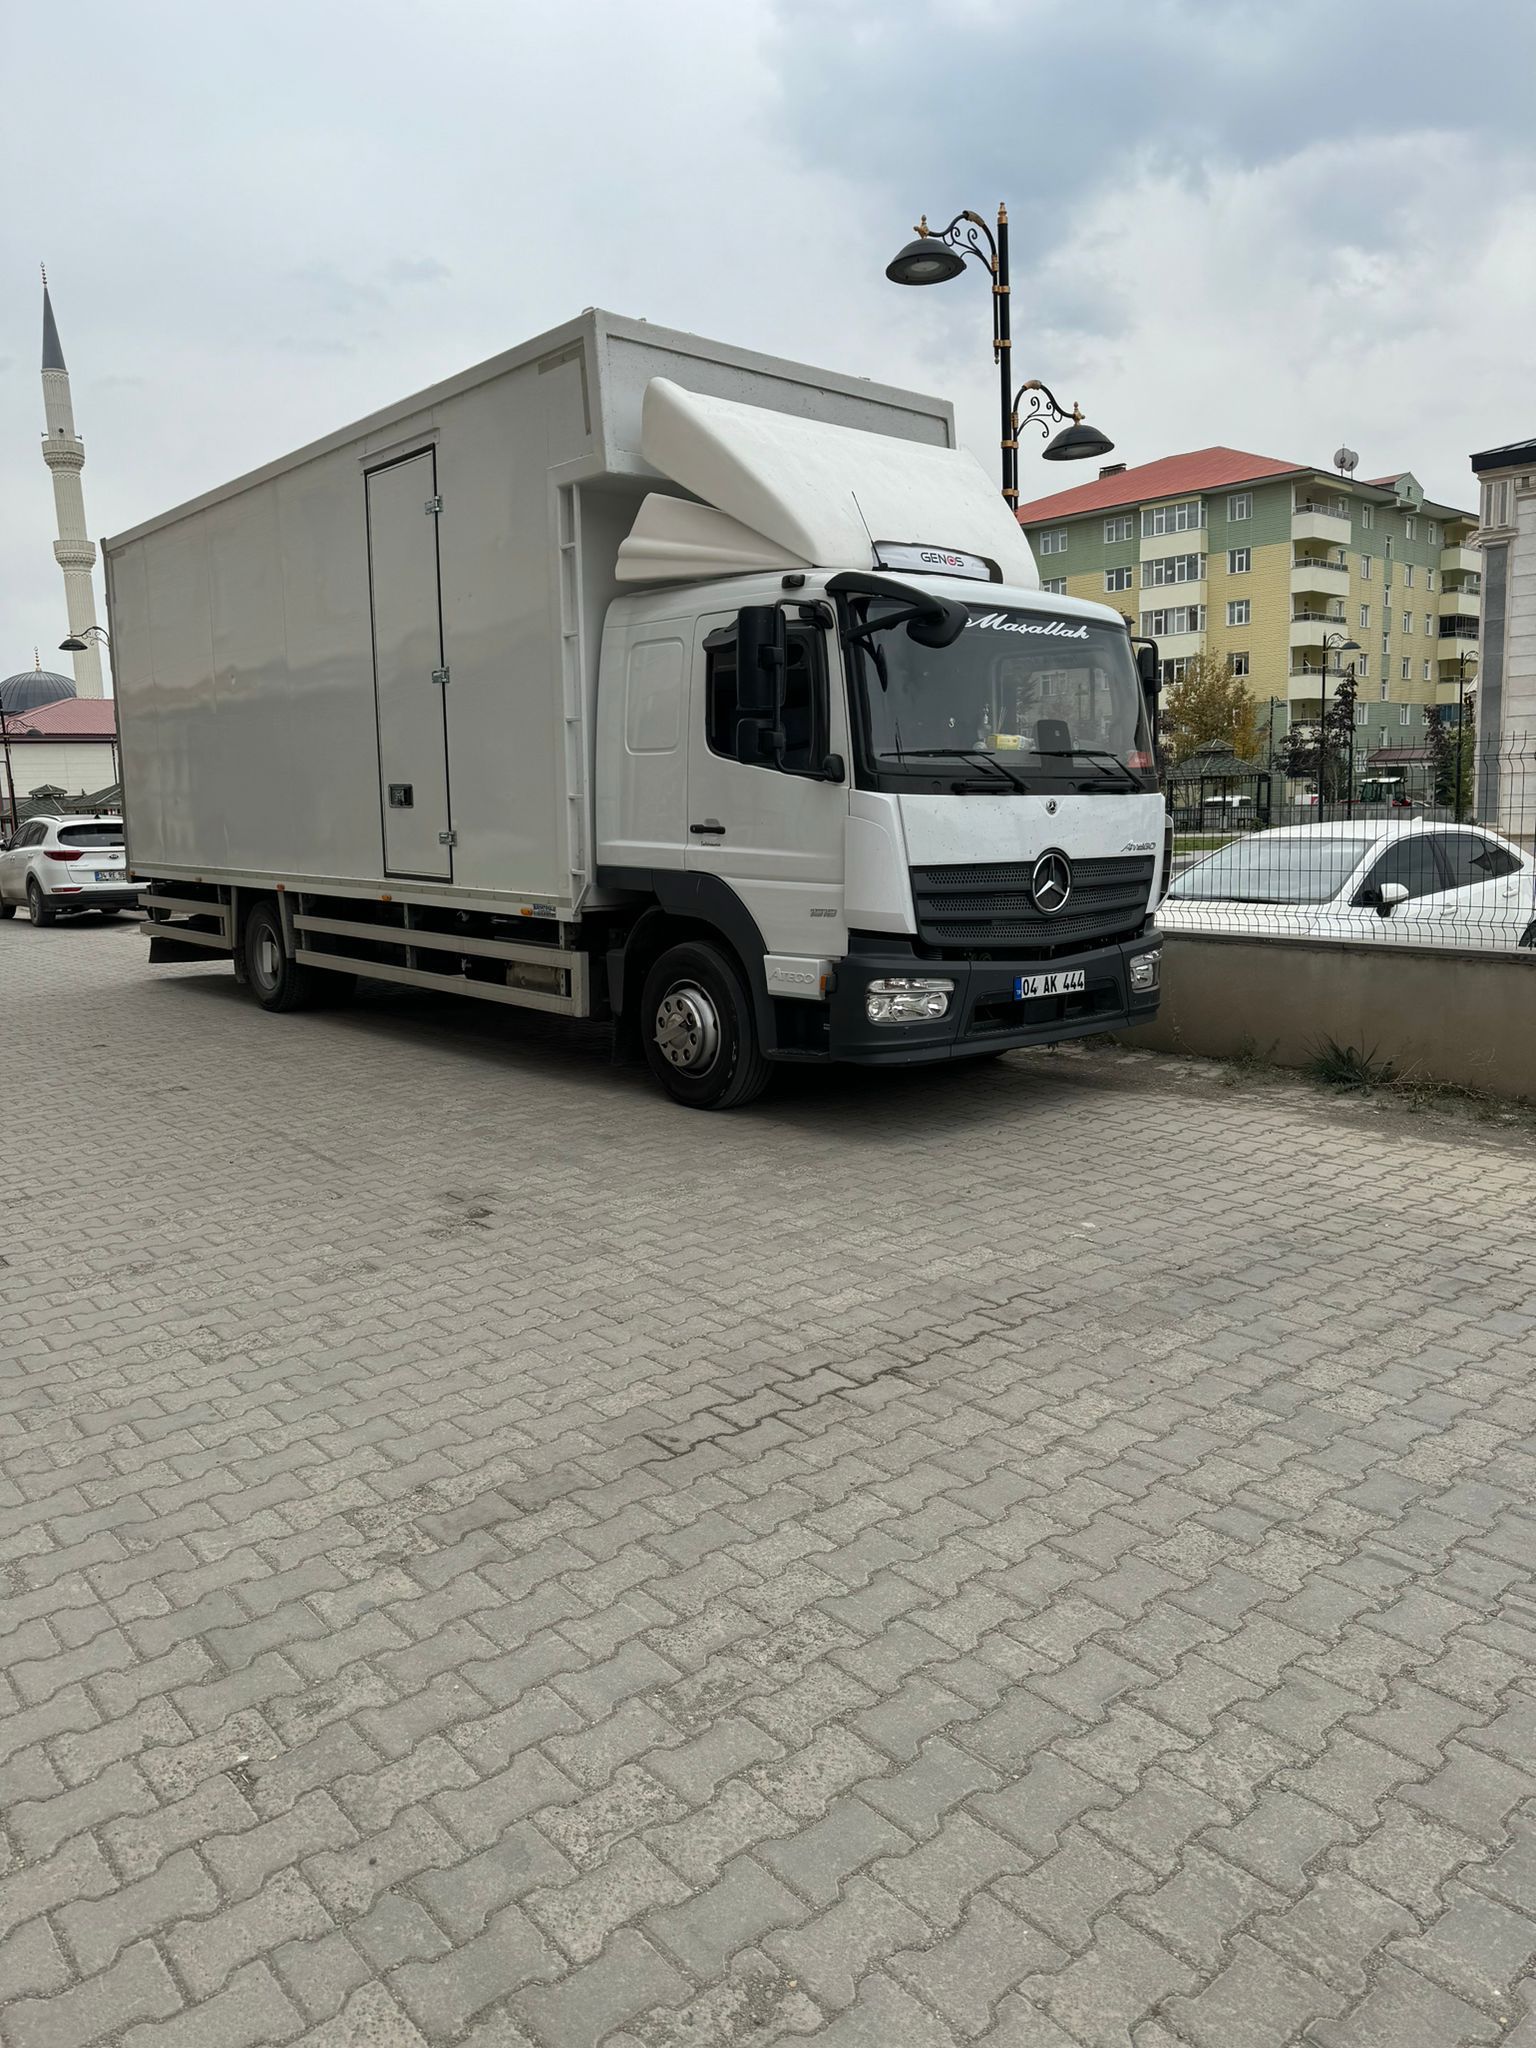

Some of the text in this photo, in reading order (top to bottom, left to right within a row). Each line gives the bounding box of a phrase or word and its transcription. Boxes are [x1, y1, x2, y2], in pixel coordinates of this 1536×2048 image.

[920, 552, 964, 567] GENOS
[1022, 972, 1084, 996] 04 AK 444
